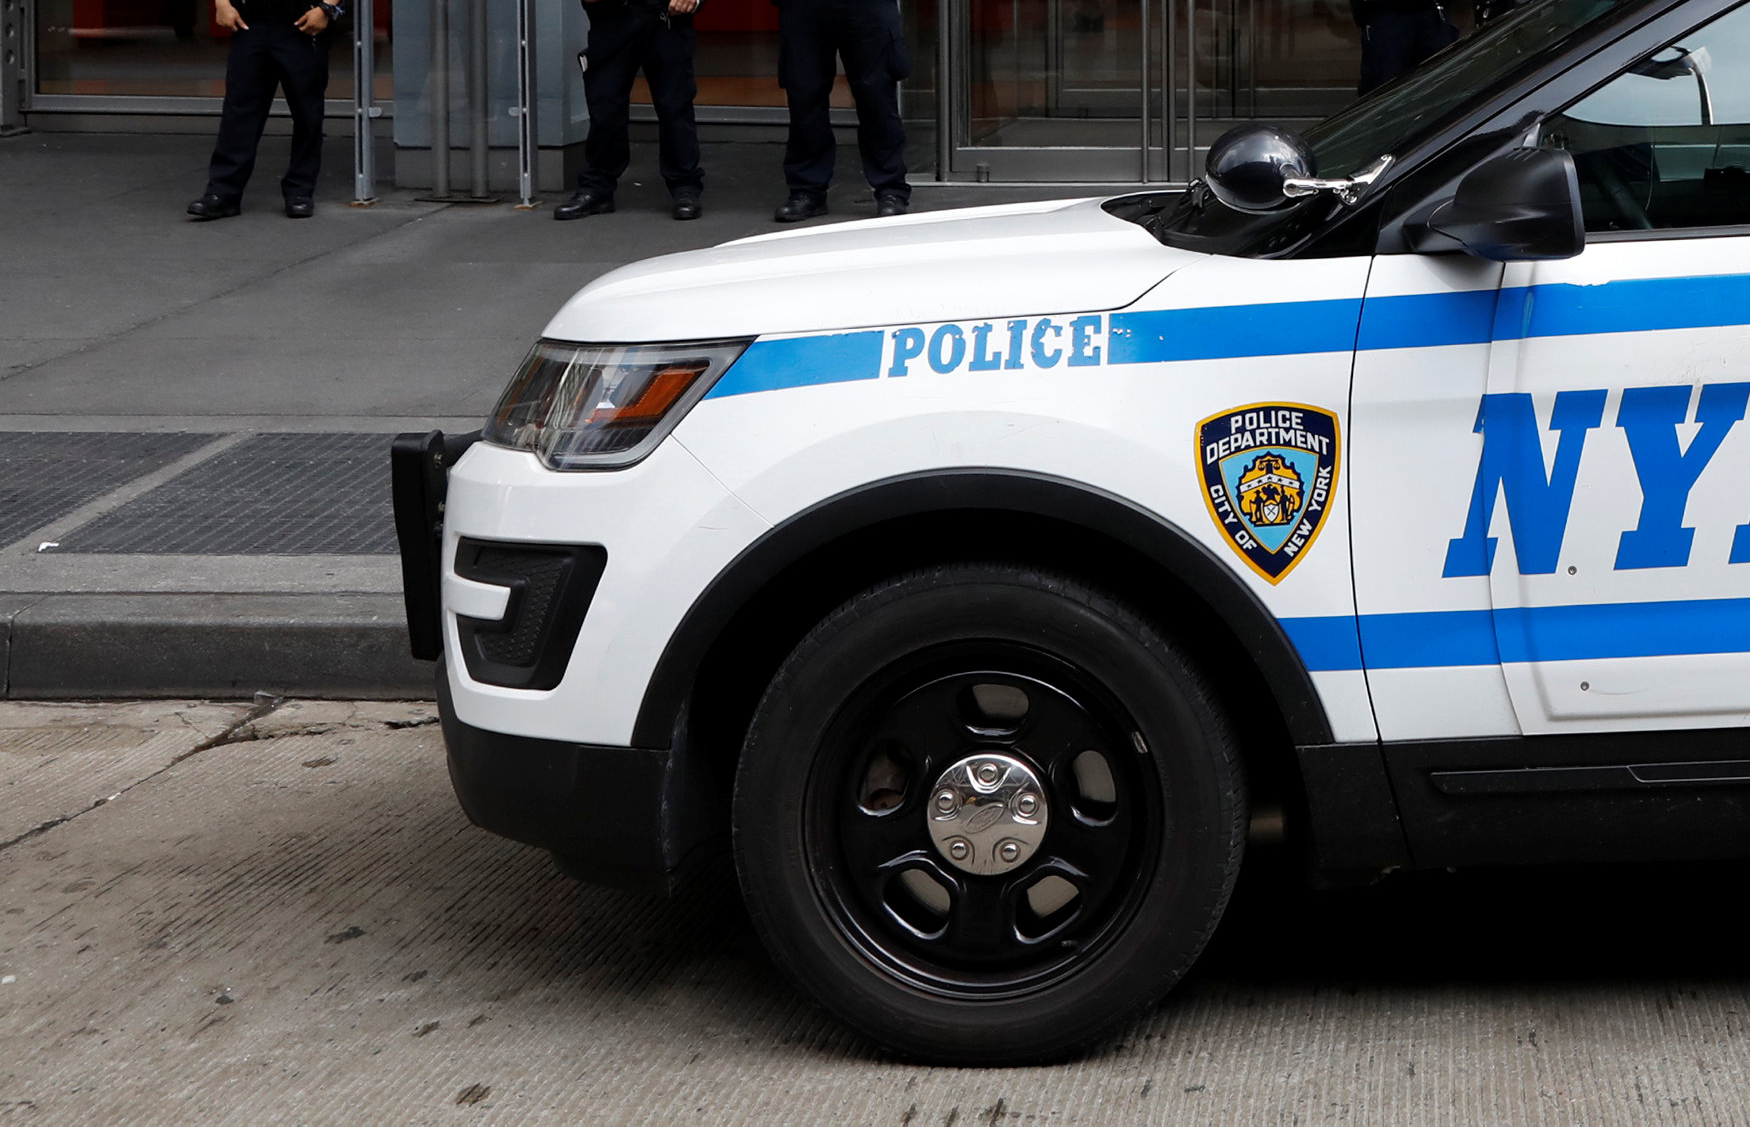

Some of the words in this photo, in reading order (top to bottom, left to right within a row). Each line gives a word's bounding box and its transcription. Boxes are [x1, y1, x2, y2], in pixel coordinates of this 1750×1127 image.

[888, 314, 1102, 378] POLICE
[1206, 428, 1329, 465] DEPARTMENT
[1230, 410, 1304, 434] POLICE
[1210, 485, 1237, 524] CITY
[1234, 529, 1258, 551] OF
[1284, 518, 1313, 557] NEW
[1308, 465, 1332, 513] YORK
